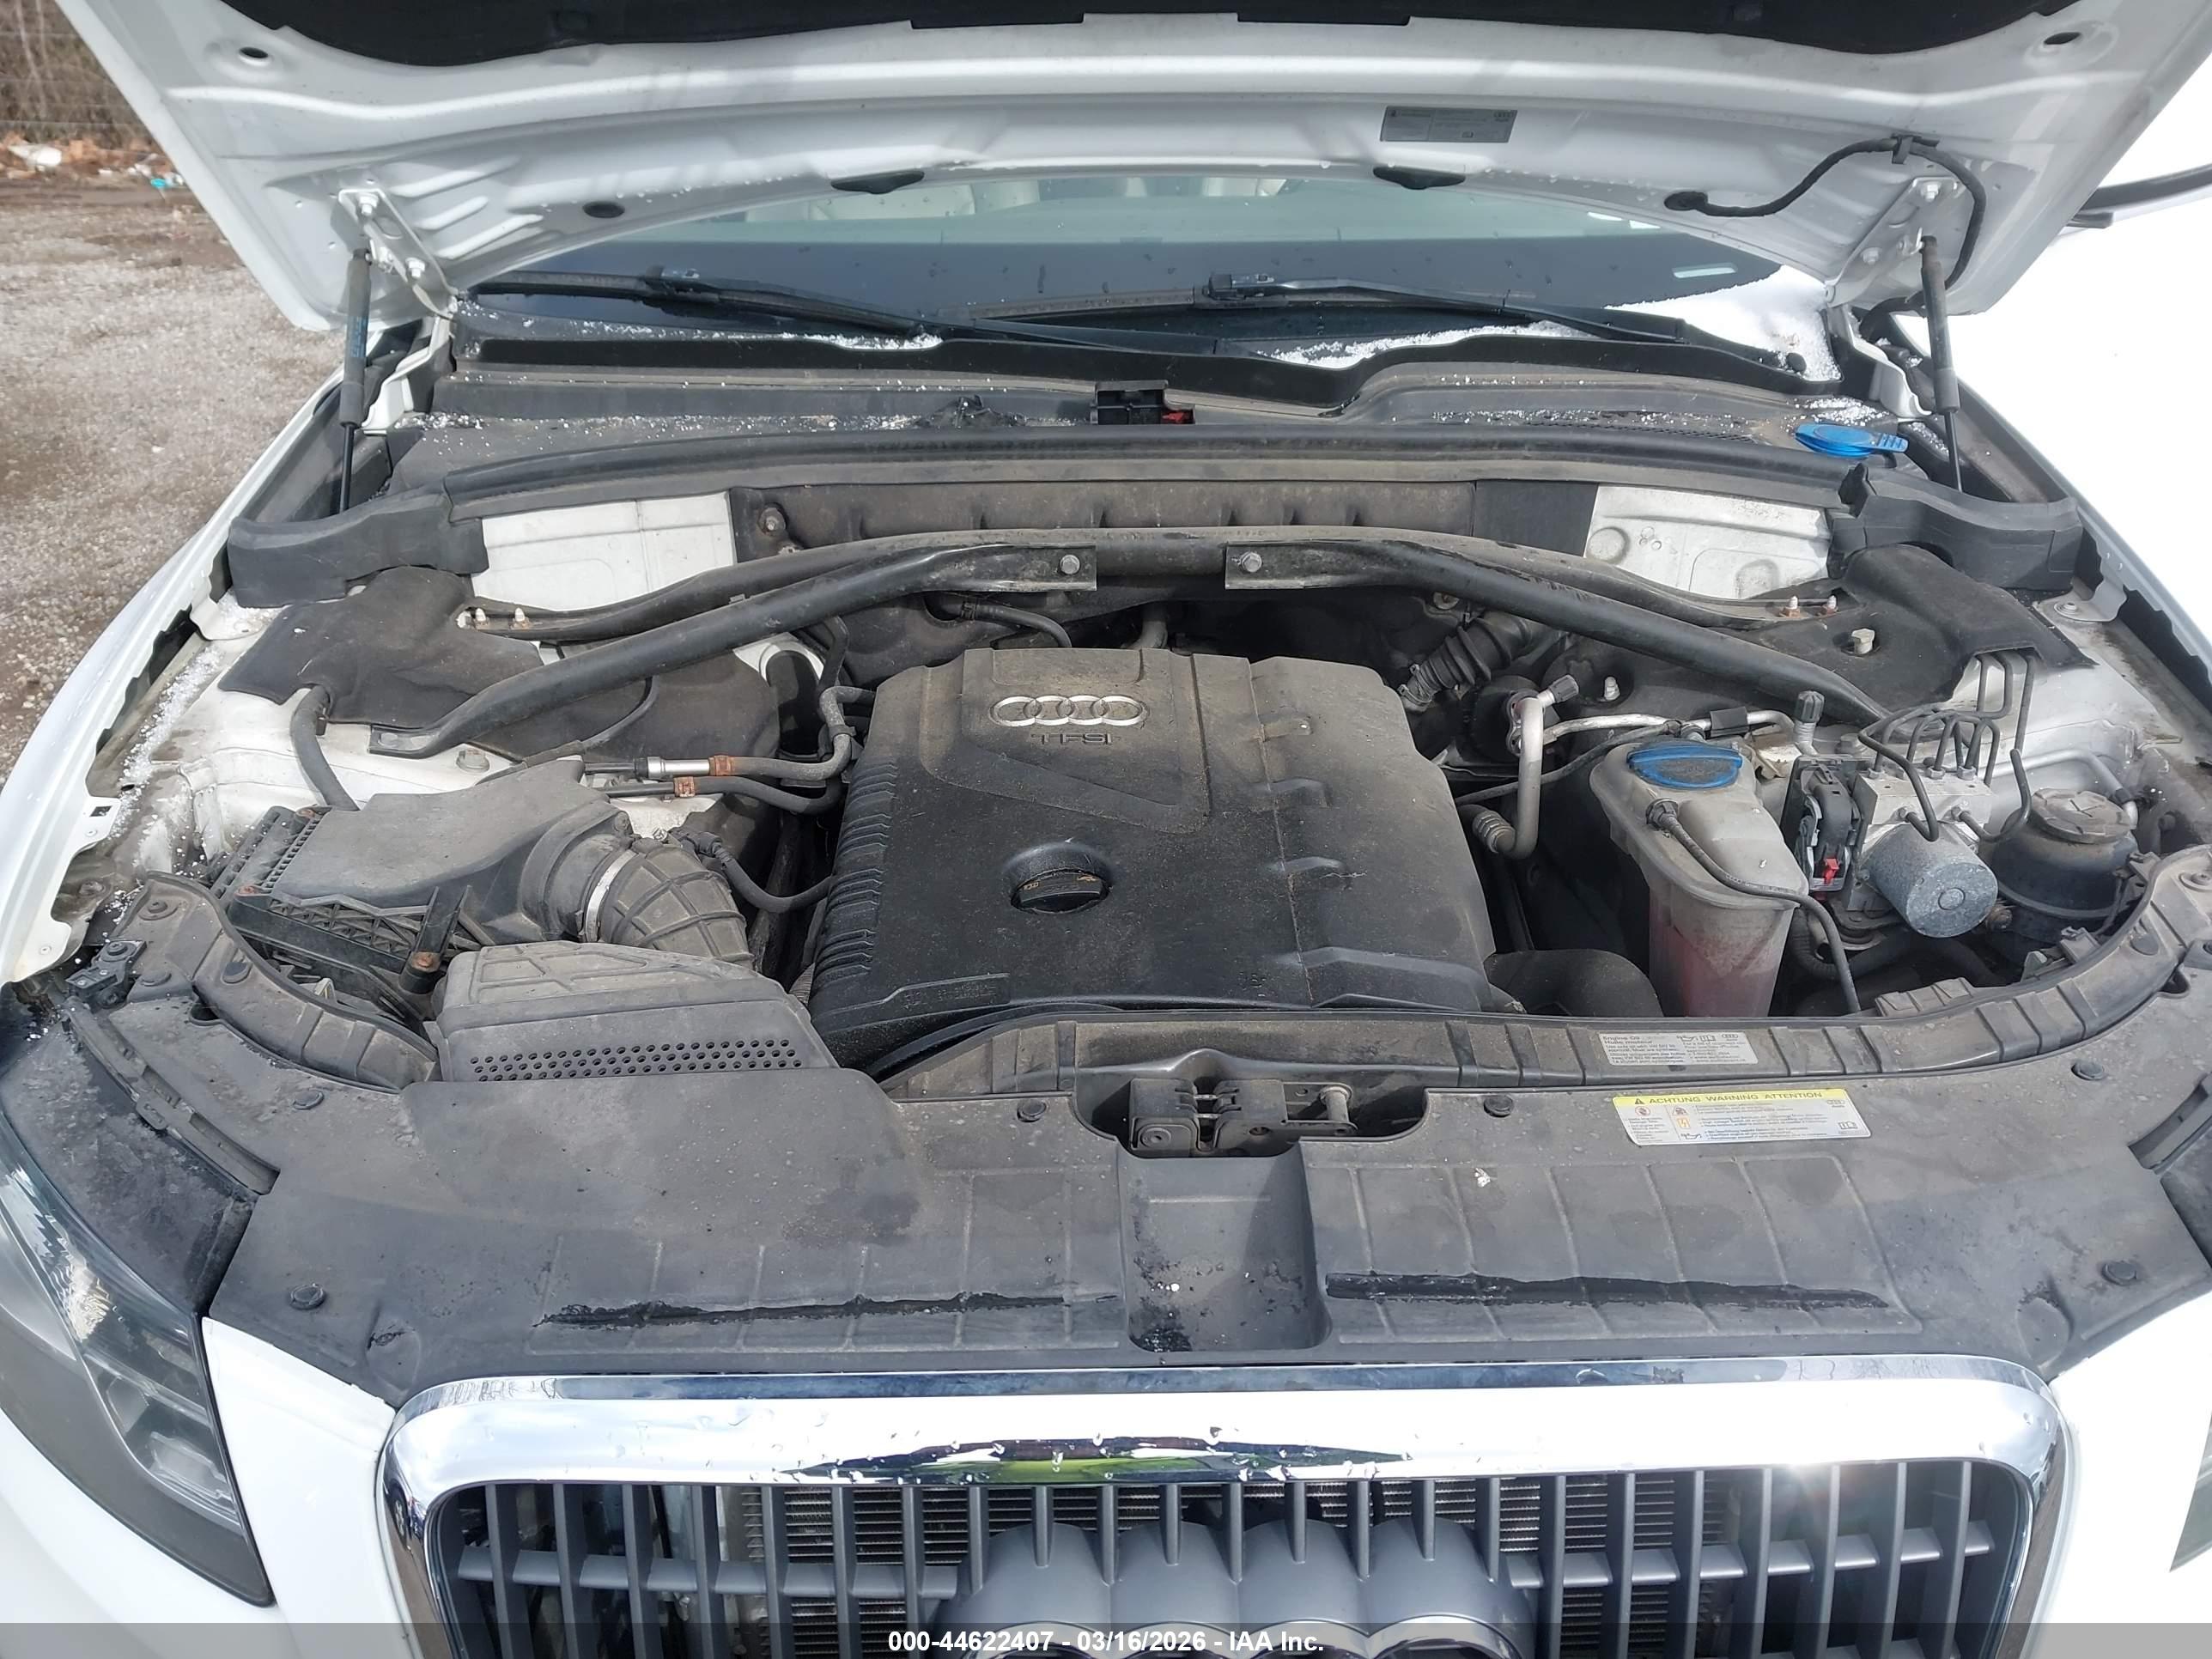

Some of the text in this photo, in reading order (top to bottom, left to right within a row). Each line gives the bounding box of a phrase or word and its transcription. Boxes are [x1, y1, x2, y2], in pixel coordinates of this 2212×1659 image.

[1030, 732, 1113, 746] TFSI
[1649, 1091, 1823, 1105] ACHTUNG WARNING ATTENTION
